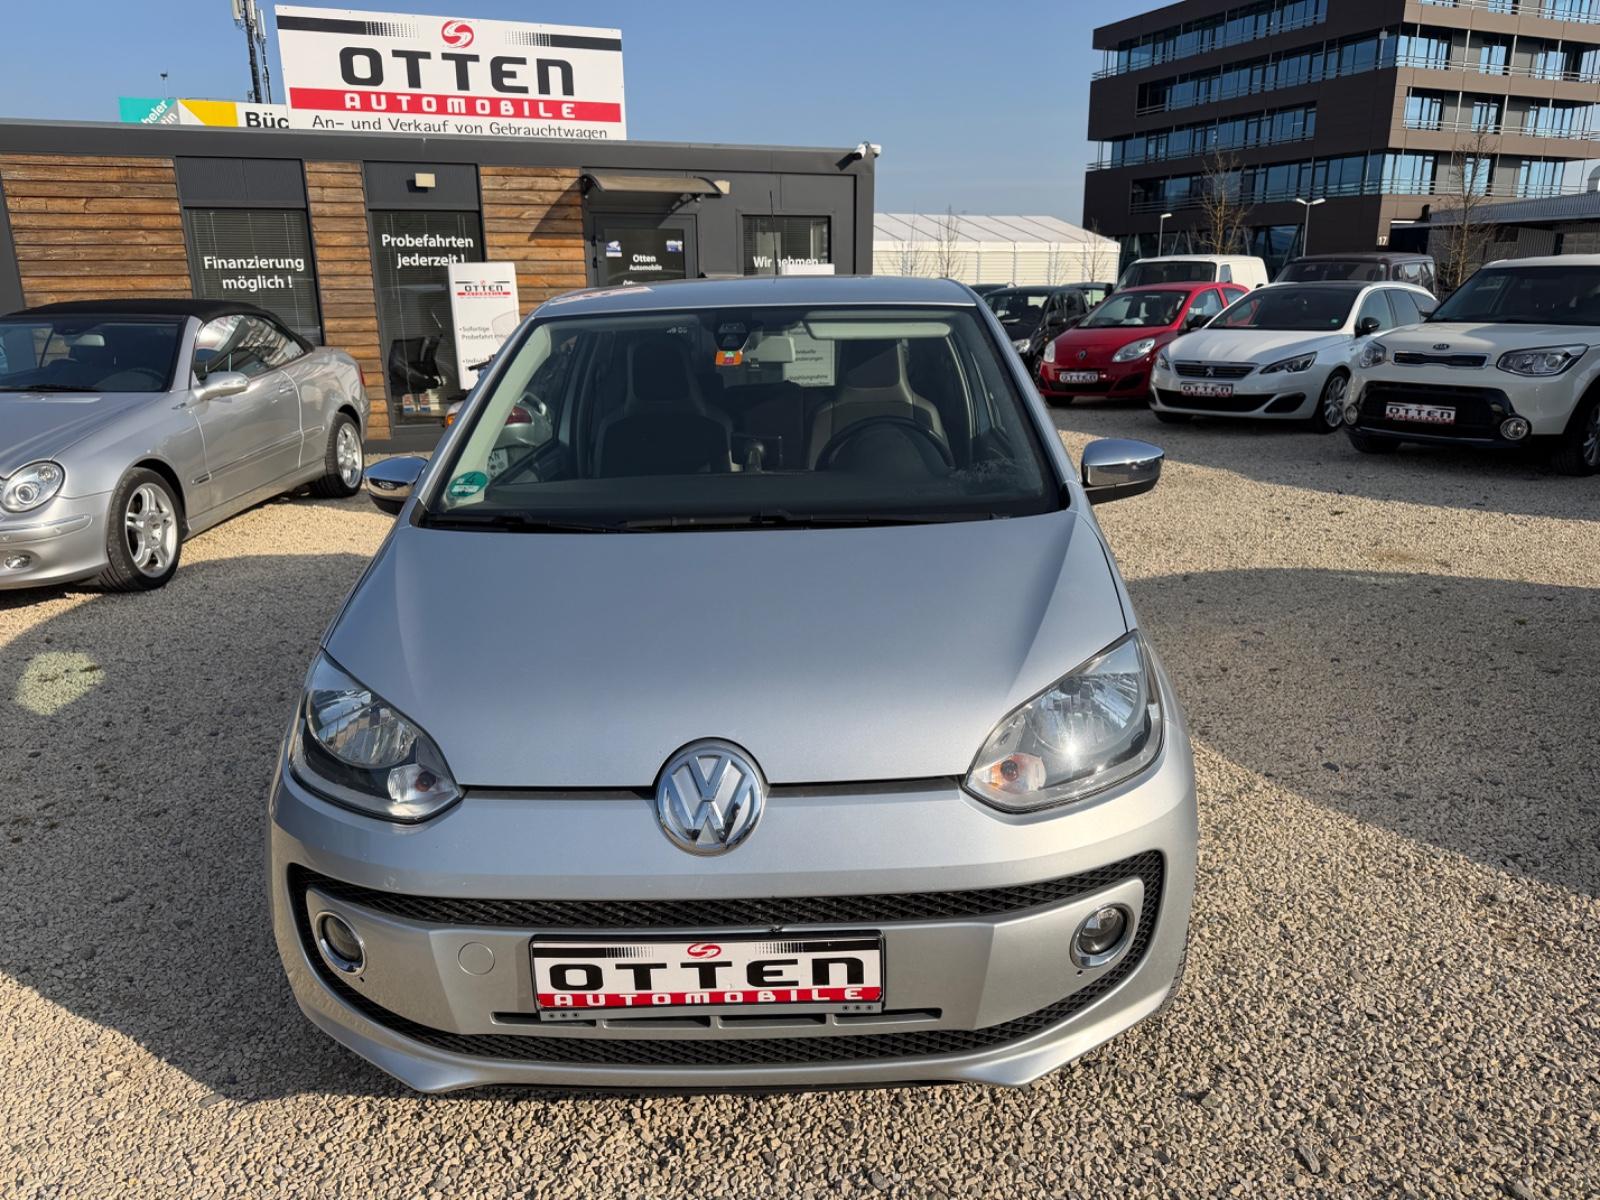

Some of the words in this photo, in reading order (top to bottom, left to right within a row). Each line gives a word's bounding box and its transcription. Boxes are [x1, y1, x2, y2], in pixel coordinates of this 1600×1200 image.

[339, 46, 575, 97] OTTEN
[344, 92, 576, 119] AUTOMOBILE
[312, 115, 344, 129] An-
[351, 118, 382, 130] und
[388, 117, 450, 133] Verkauf
[455, 122, 483, 134] von
[489, 121, 608, 140] Gebrauchtwagen
[381, 233, 474, 248] Probefahrten
[203, 255, 305, 272] Finanzierung
[396, 252, 458, 270] jederzeit
[632, 253, 657, 263] Otten
[752, 255, 773, 268] Wir
[222, 274, 285, 292] möglich
[287, 274, 293, 289] !
[1389, 407, 1452, 419] OTTEN
[548, 956, 866, 992] OTTEN
[553, 986, 864, 1007] AUTOMOBILE
